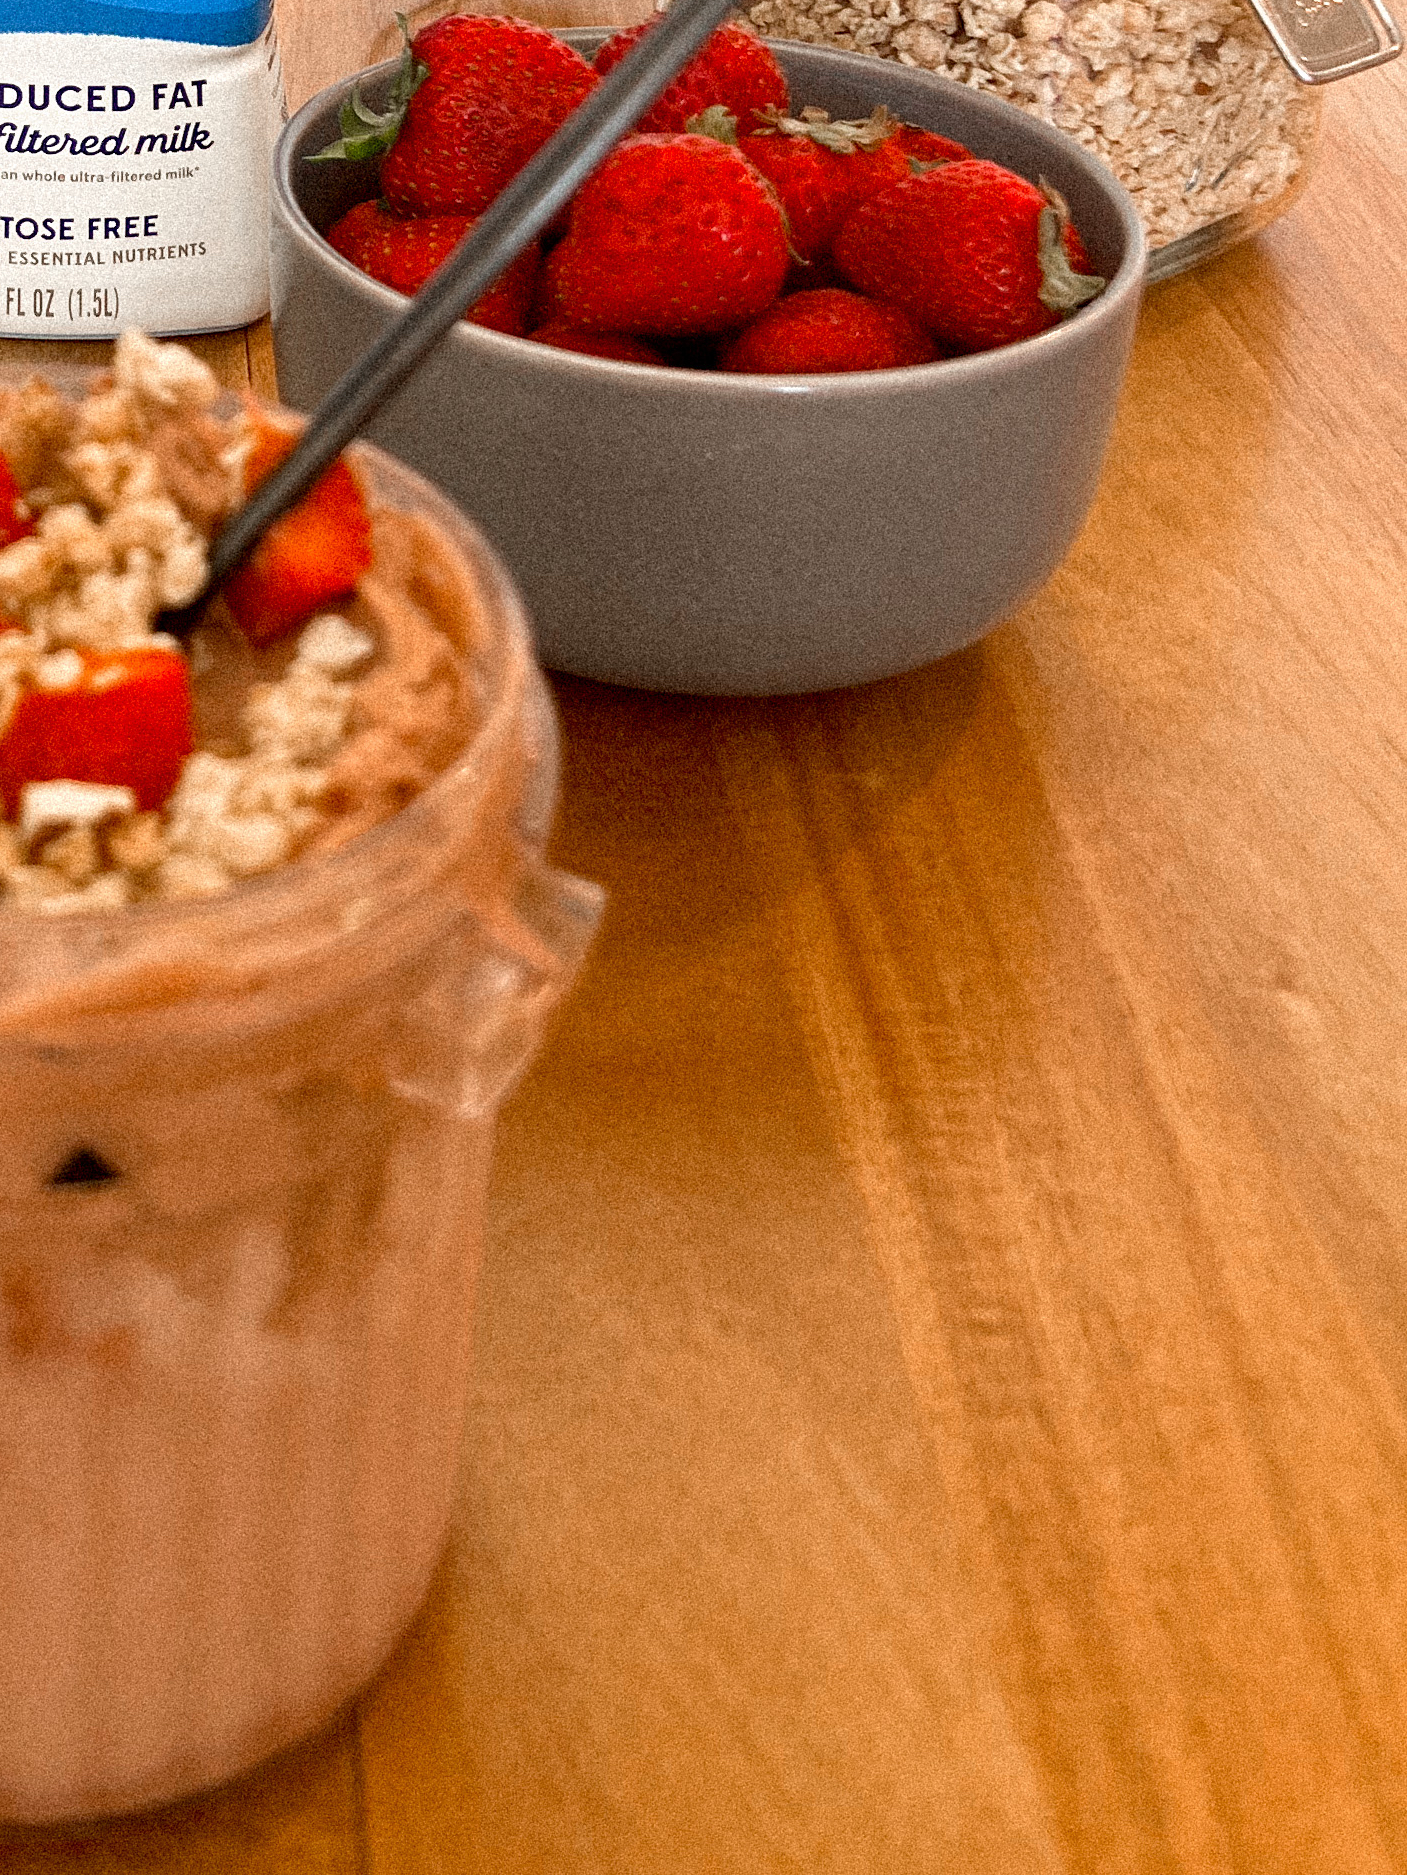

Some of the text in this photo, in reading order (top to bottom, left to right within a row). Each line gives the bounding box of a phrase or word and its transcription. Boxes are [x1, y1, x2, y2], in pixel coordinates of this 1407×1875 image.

[152, 78, 208, 111] FAT
[134, 121, 214, 156] milk
[22, 170, 66, 182] whole
[70, 169, 162, 183] ultra-filtered
[88, 214, 159, 240] FREE
[8, 250, 106, 266] ESSENTIAL
[112, 241, 207, 264] NUTRIENTS
[6, 286, 26, 316] FL
[33, 288, 55, 318] OZ
[68, 287, 120, 322] (1.5L)
